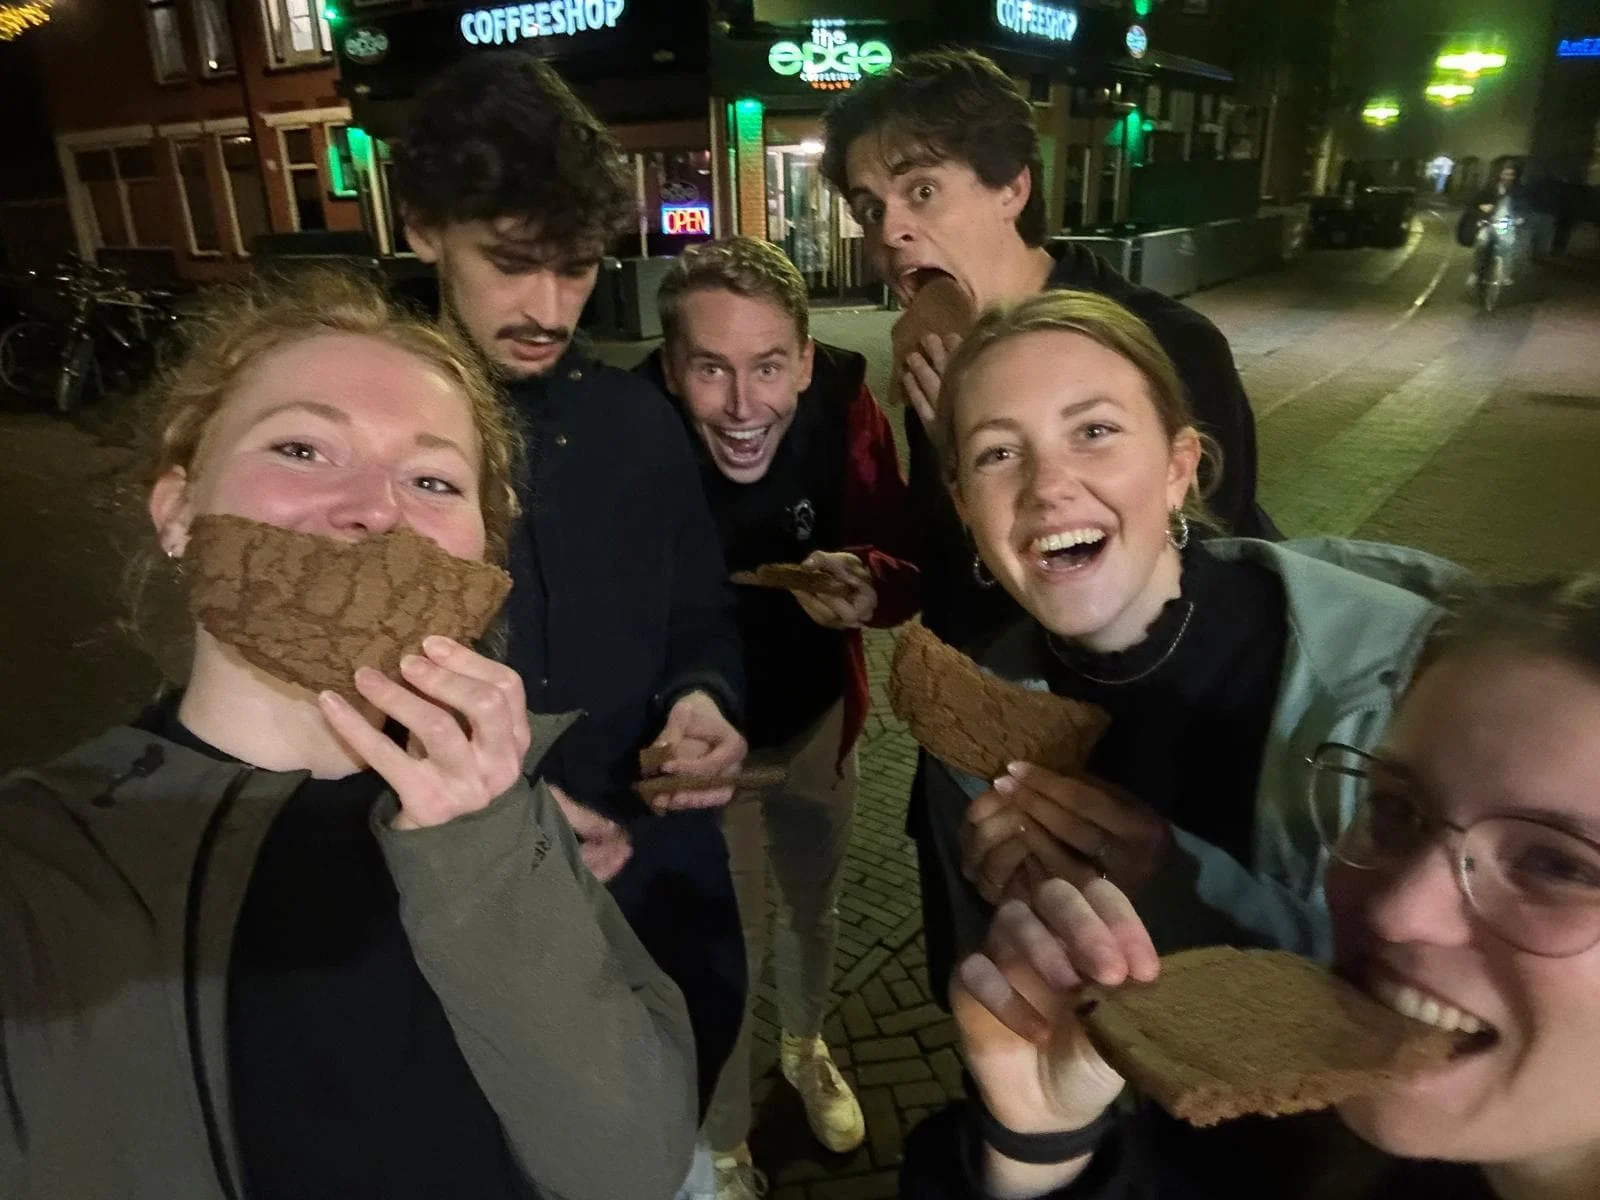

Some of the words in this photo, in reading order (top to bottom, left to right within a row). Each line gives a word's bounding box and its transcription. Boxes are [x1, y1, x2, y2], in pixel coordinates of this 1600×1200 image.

[460, 0, 625, 45] COFFEESHOP
[996, 0, 1078, 41] COFFEESHOP
[811, 28, 847, 51] the
[667, 211, 706, 234] OPEN
